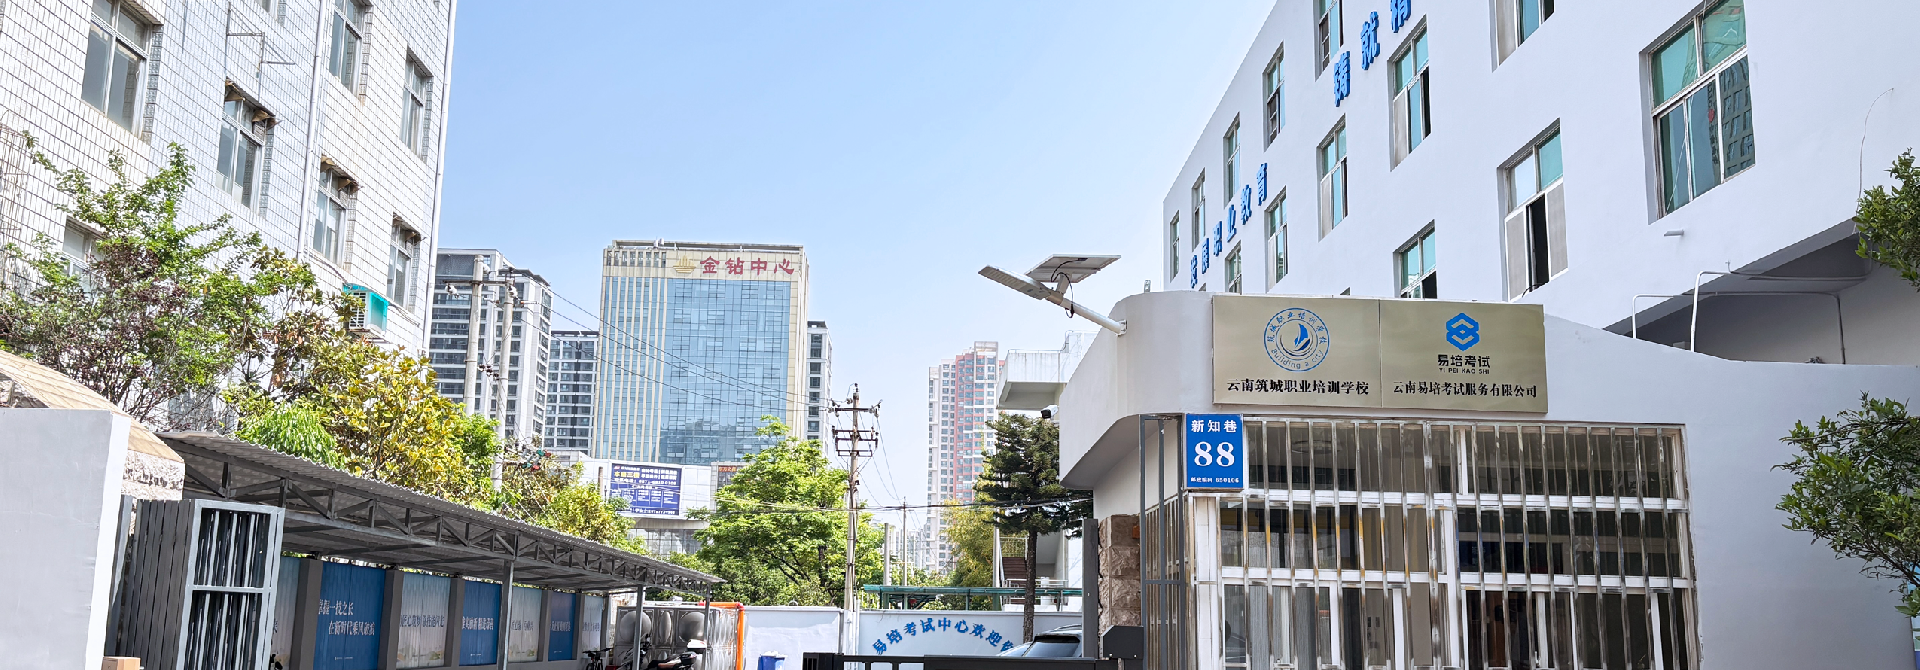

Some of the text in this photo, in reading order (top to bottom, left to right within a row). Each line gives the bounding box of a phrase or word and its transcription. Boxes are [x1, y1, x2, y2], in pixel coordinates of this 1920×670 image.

[700, 255, 794, 275] 金钻中心
[1438, 354, 1491, 368] 易培考试
[1227, 378, 1369, 395] 云南筑城职业培训学校
[1393, 381, 1537, 398] 云南易培考试服务有限公司
[1191, 419, 1237, 433] 新知巷
[1194, 441, 1235, 467] 88
